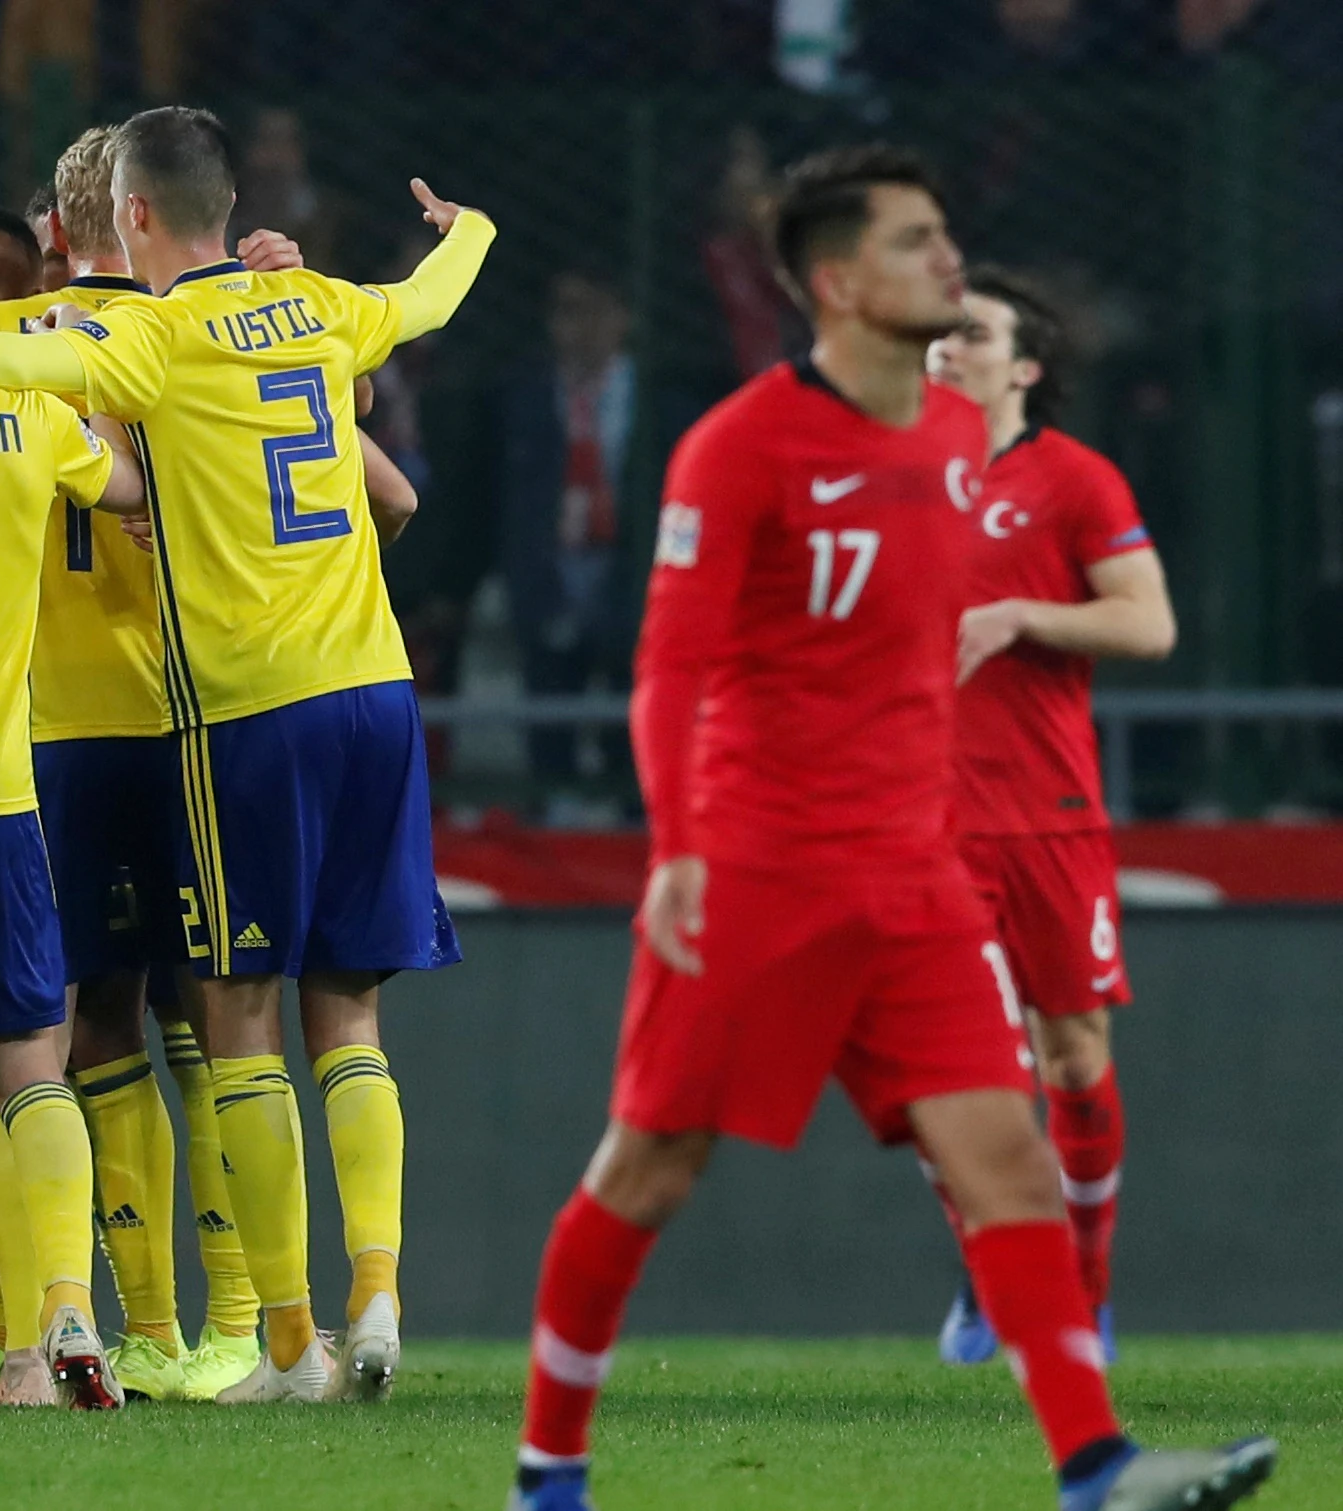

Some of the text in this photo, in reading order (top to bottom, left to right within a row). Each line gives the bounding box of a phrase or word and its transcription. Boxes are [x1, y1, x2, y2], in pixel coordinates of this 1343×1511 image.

[257, 366, 353, 545] 2
[807, 529, 880, 620] 17
[179, 887, 210, 958] 2
[234, 939, 271, 948] adidas
[1090, 896, 1117, 961] 6
